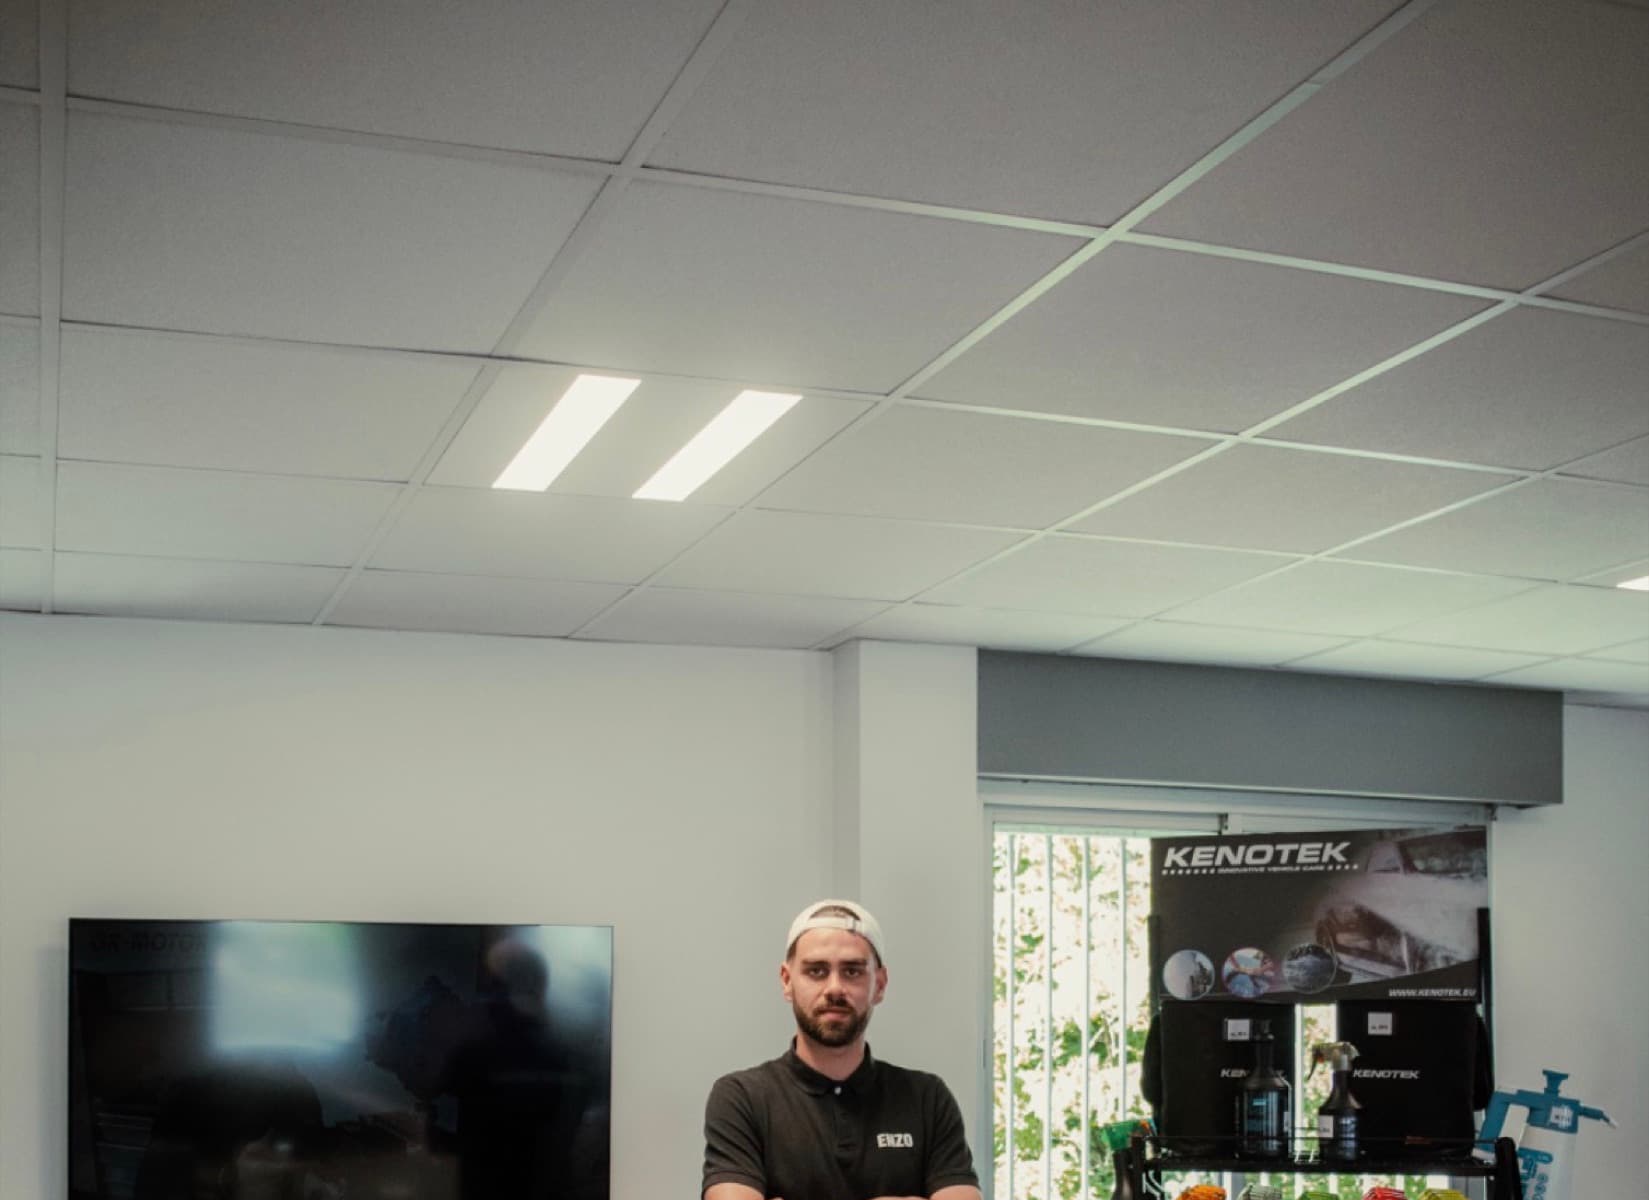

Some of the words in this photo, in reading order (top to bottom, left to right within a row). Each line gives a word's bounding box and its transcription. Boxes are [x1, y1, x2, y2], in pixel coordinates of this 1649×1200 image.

[1163, 842, 1352, 868] KENOTEK
[1388, 988, 1477, 997] WWW.KENOTEK.EU
[1352, 1068, 1421, 1080] KENOTEK
[876, 1132, 914, 1148] ENZO
